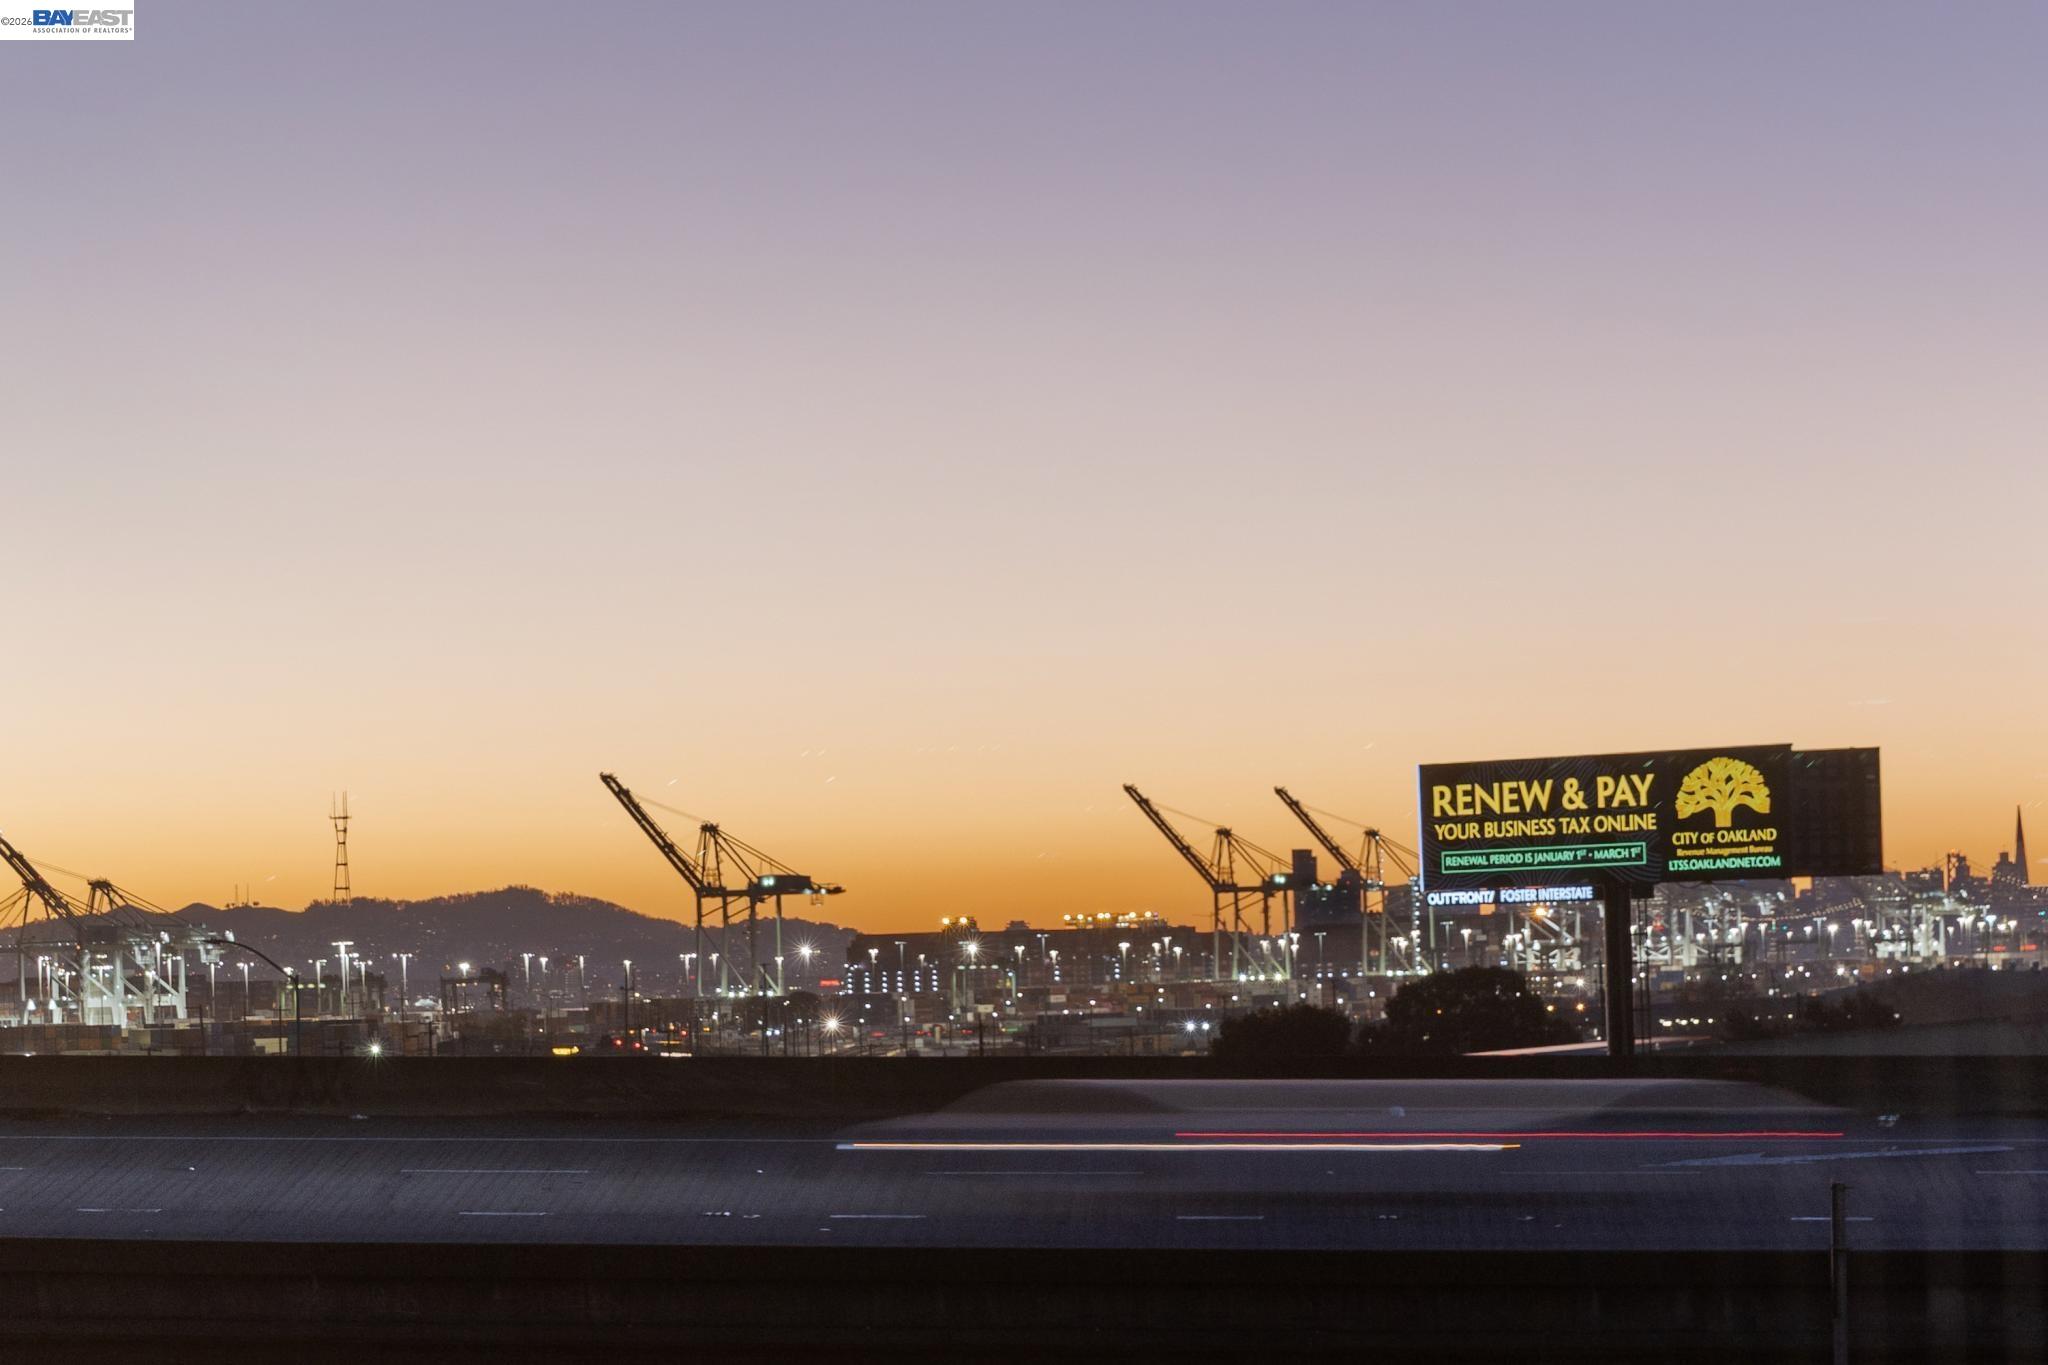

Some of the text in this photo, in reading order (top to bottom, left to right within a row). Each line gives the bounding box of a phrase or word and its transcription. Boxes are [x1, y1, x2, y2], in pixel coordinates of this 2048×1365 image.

[1432, 773, 1655, 817] RENEW & PAY
[1434, 813, 1657, 841] YOUR BUSINESS TAX ONLINE
[1672, 828, 1777, 845] CITY OF OAKLAND
[1445, 855, 1489, 867] RENEWAL
[1489, 853, 1524, 865] PERIOD
[1524, 852, 1533, 863] IS
[1533, 850, 1575, 865] JANUARY
[1594, 848, 1629, 860] MARCH
[1668, 856, 1781, 871] LTSS.OAKLANDNET.COM
[1500, 888, 1537, 903] FOSTER
[1538, 886, 1593, 901] INTERSTATE
